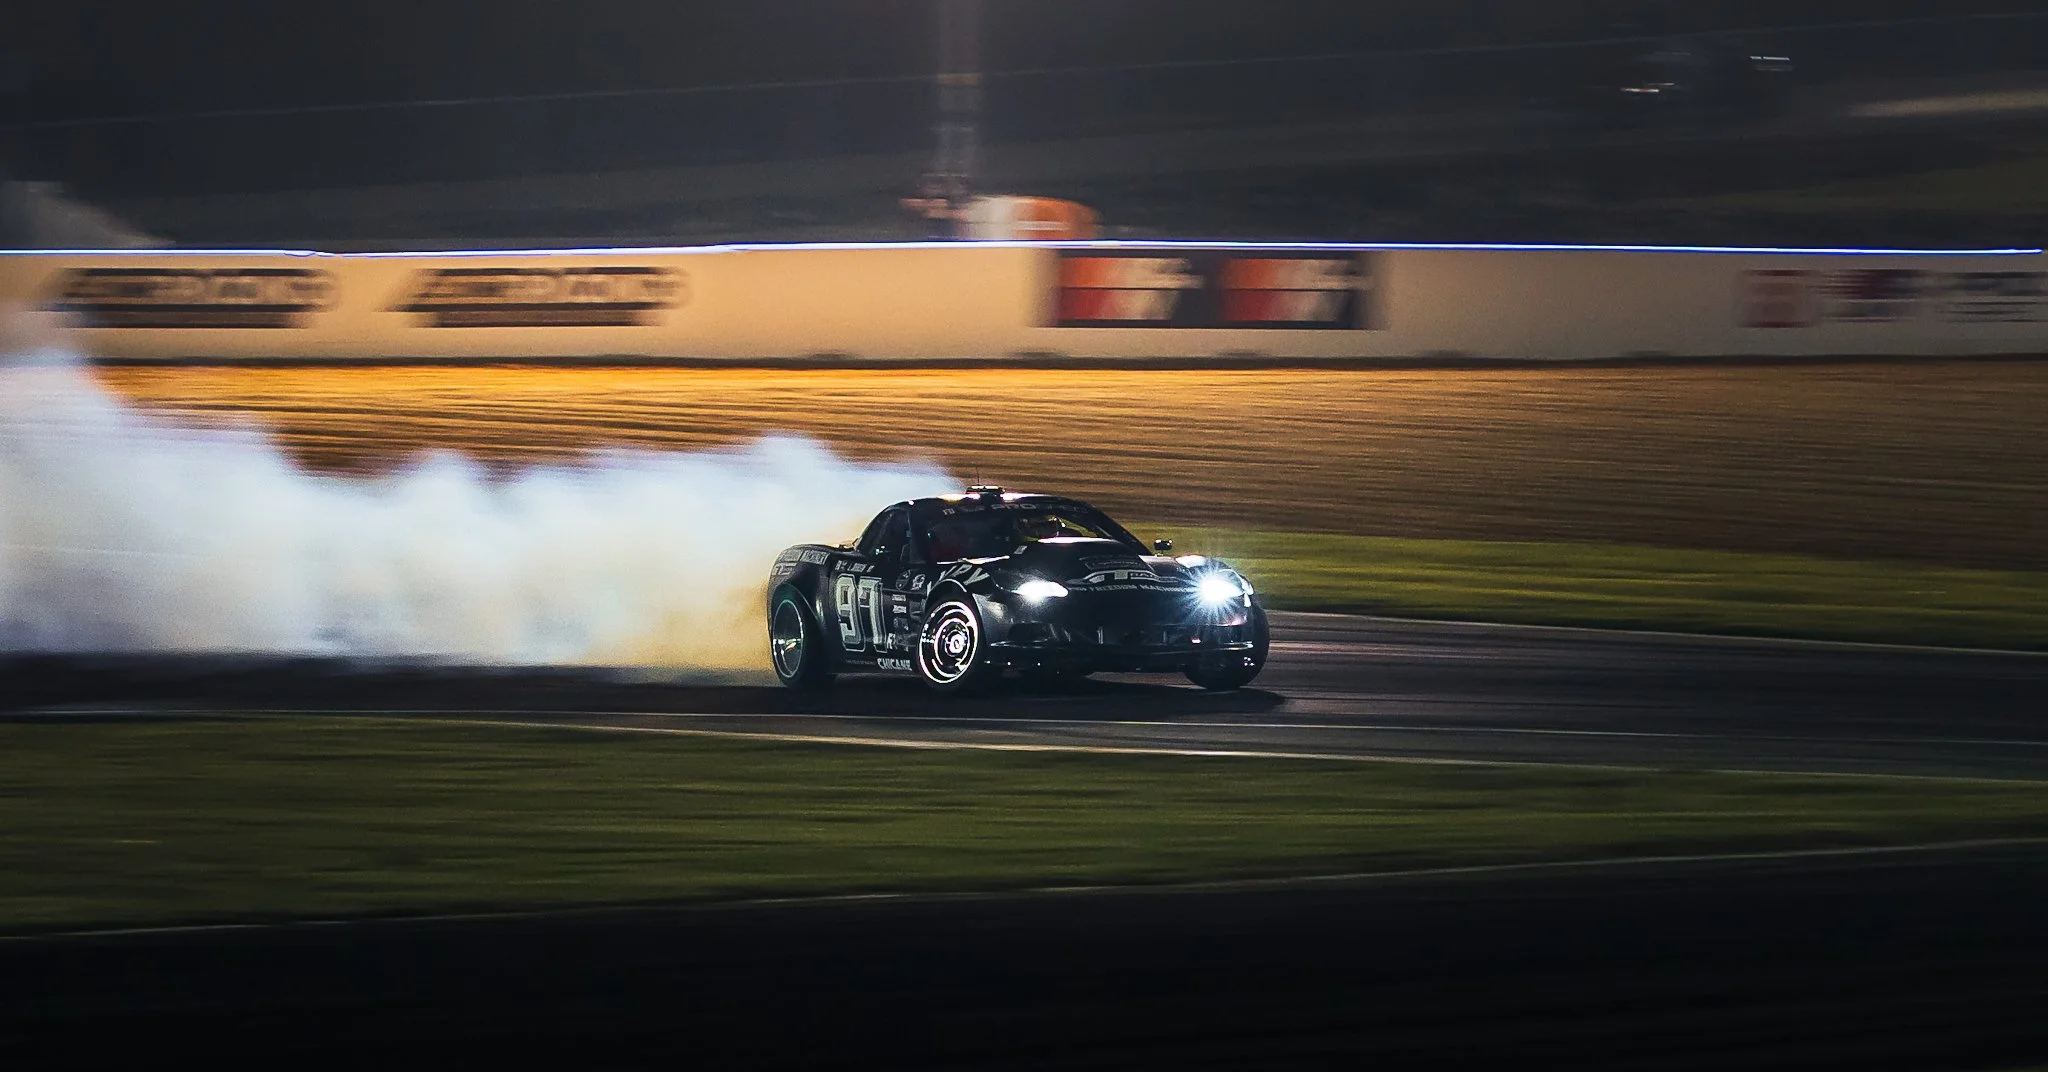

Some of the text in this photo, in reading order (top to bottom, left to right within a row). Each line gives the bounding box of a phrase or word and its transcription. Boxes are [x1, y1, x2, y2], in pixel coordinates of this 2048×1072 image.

[1089, 584, 1138, 592] FREEDOM
[835, 573, 887, 653] 97
[877, 658, 912, 671] CHICANE
